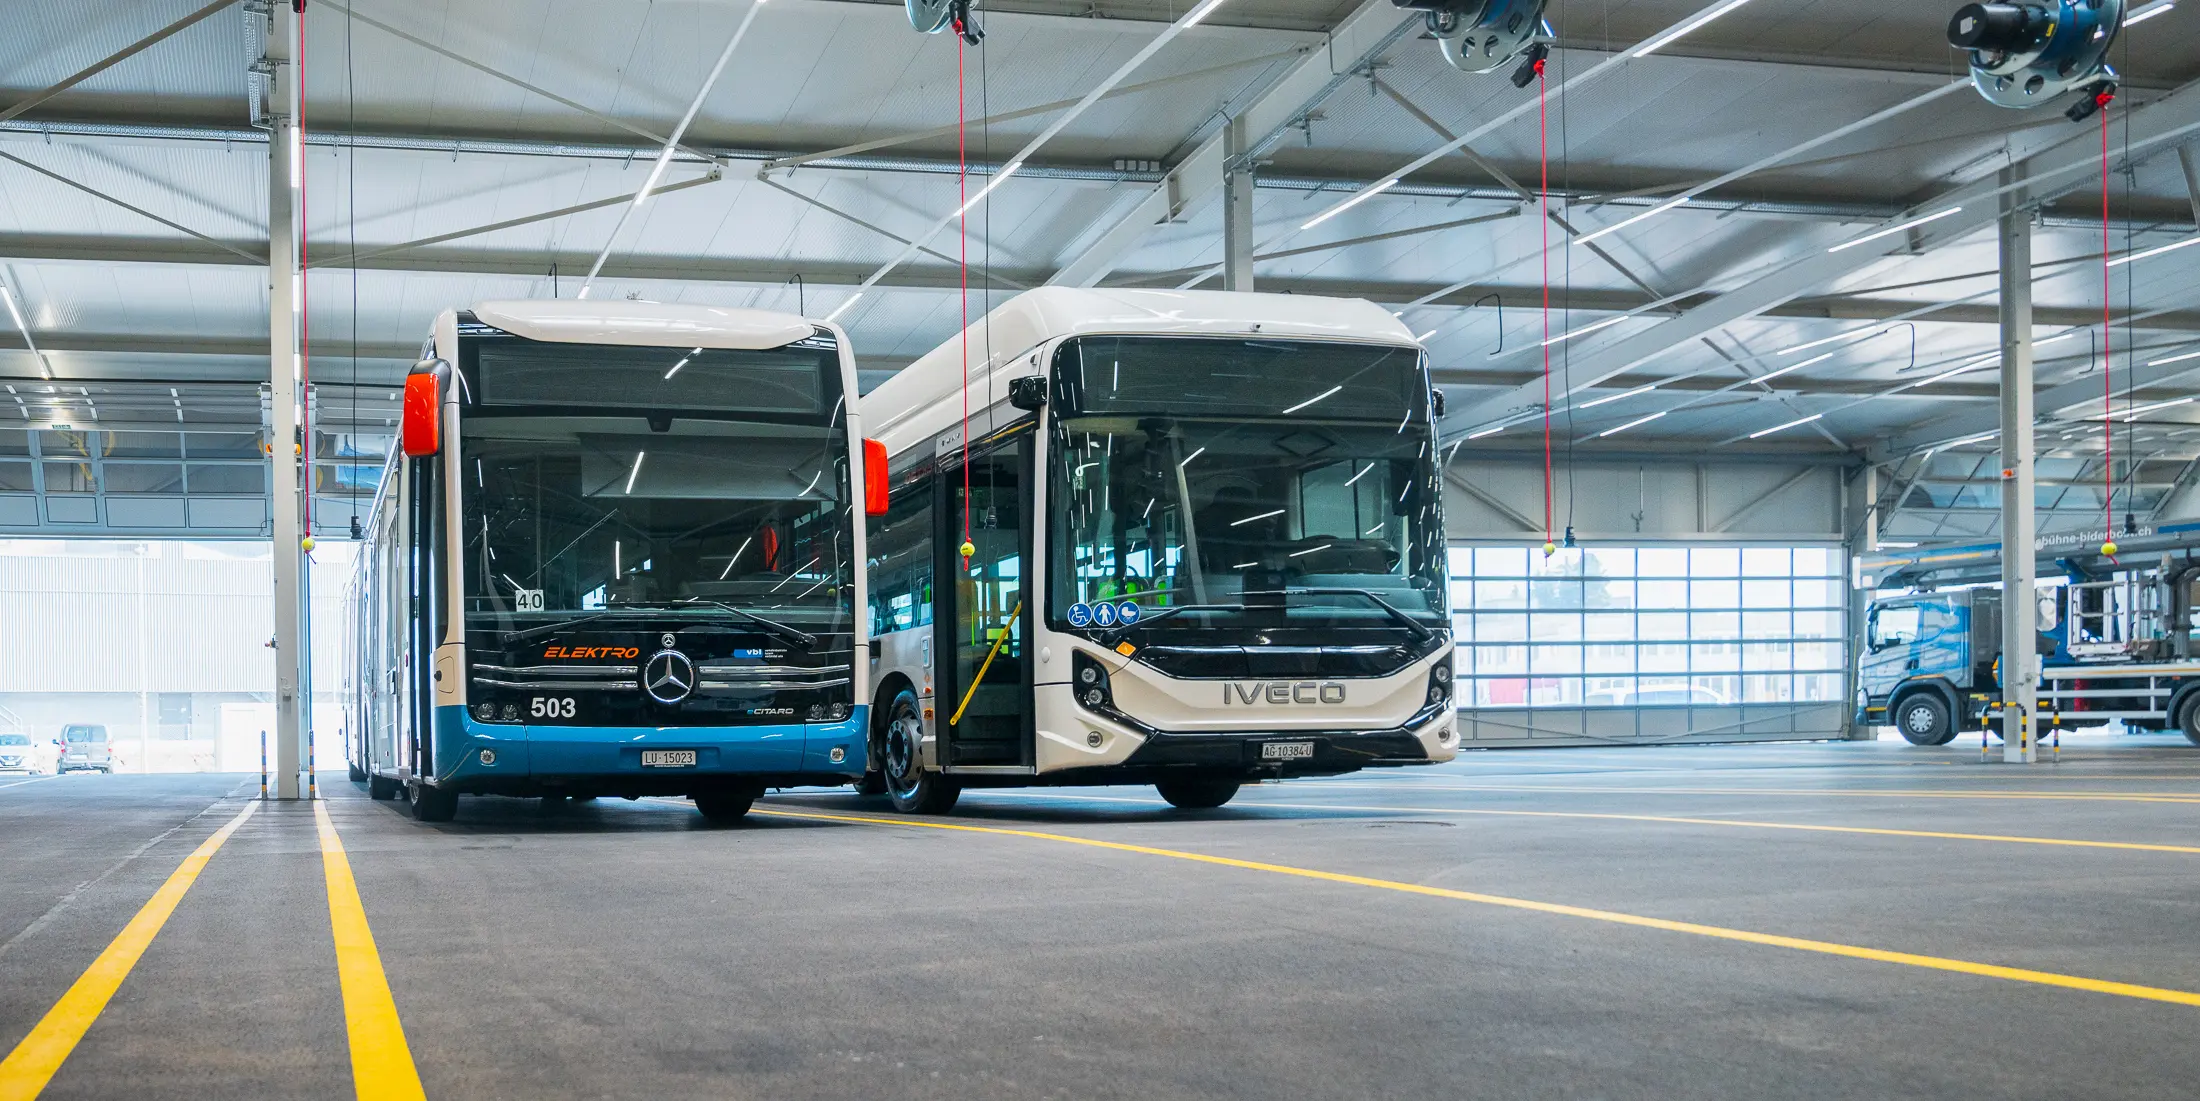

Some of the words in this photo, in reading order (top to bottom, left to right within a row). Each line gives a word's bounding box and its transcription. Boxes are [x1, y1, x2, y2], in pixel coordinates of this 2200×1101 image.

[2036, 525, 2152, 546] bühne-biderbo.ch
[517, 593, 543, 609] 40
[543, 646, 640, 659] ELEKTRO
[746, 648, 762, 656] vbl
[1223, 681, 1347, 706] IVECO
[530, 697, 576, 718] 503
